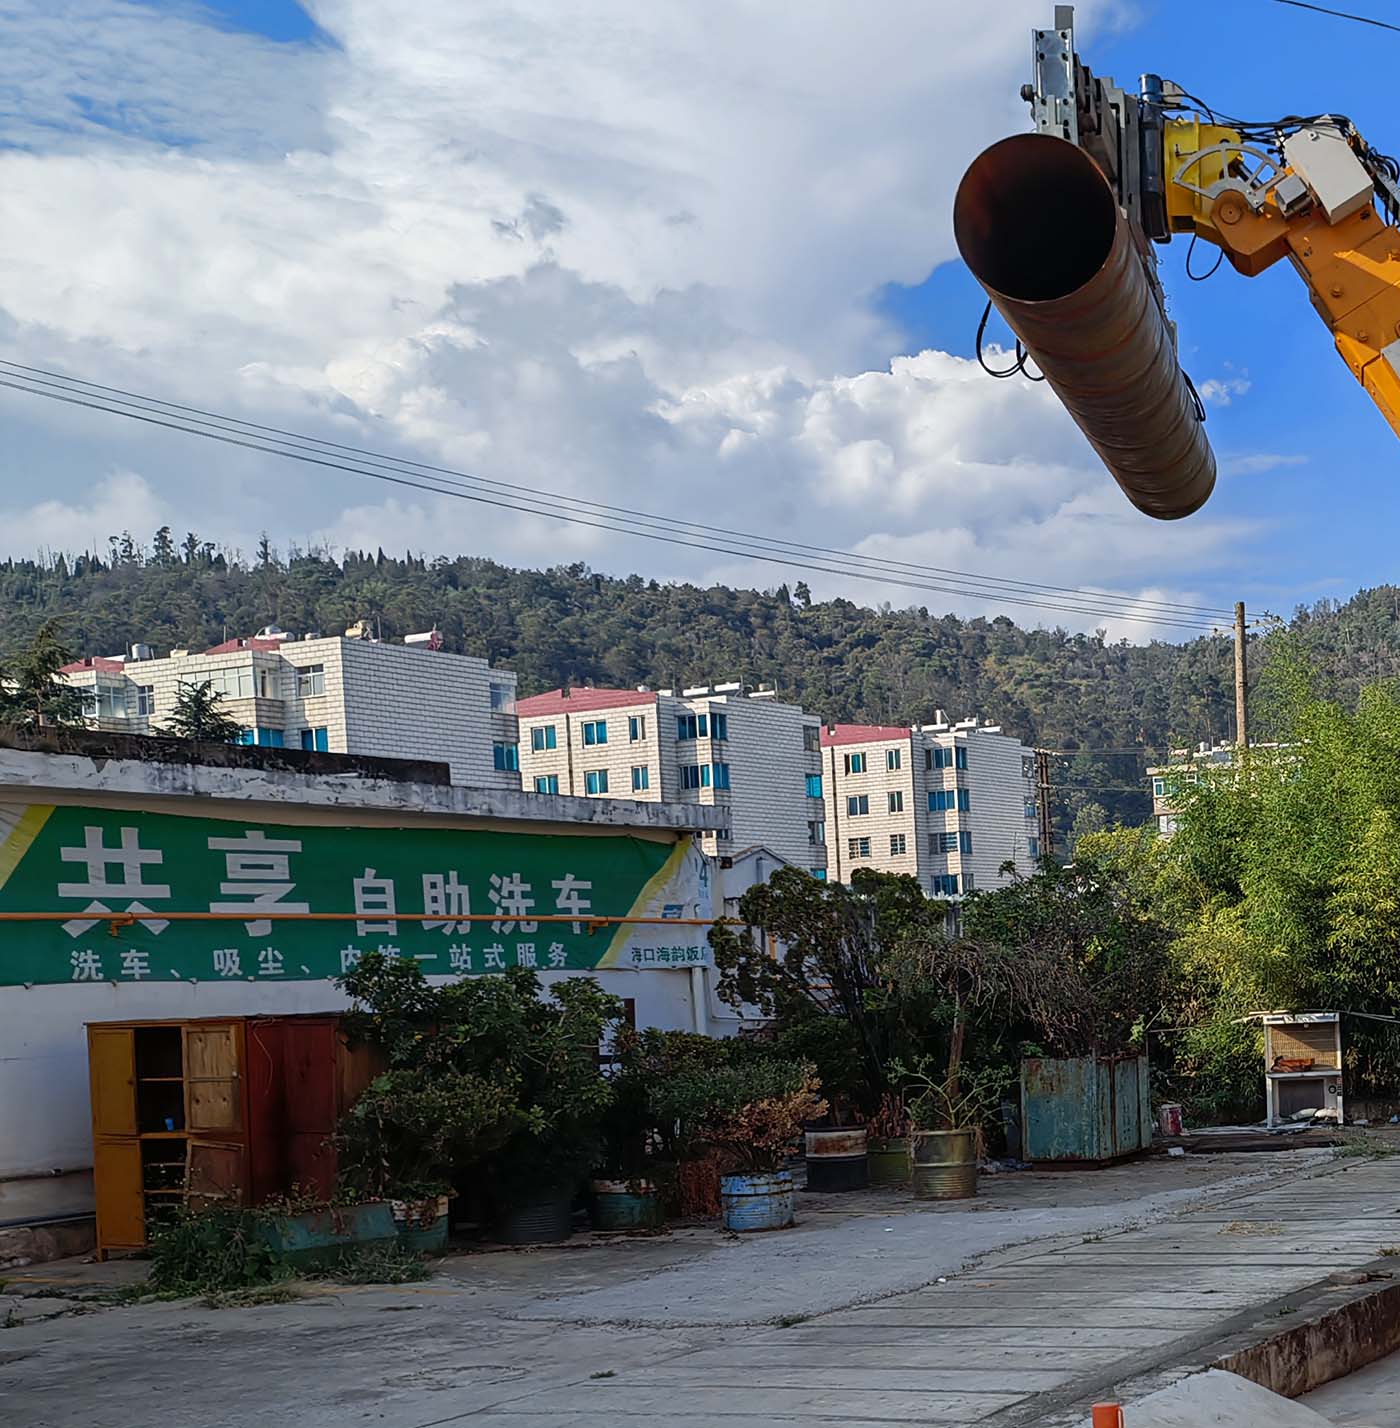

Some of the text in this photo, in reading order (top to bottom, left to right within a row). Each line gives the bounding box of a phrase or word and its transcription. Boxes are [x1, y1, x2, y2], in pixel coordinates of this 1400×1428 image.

[58, 826, 596, 938] 共享 自助洗车
